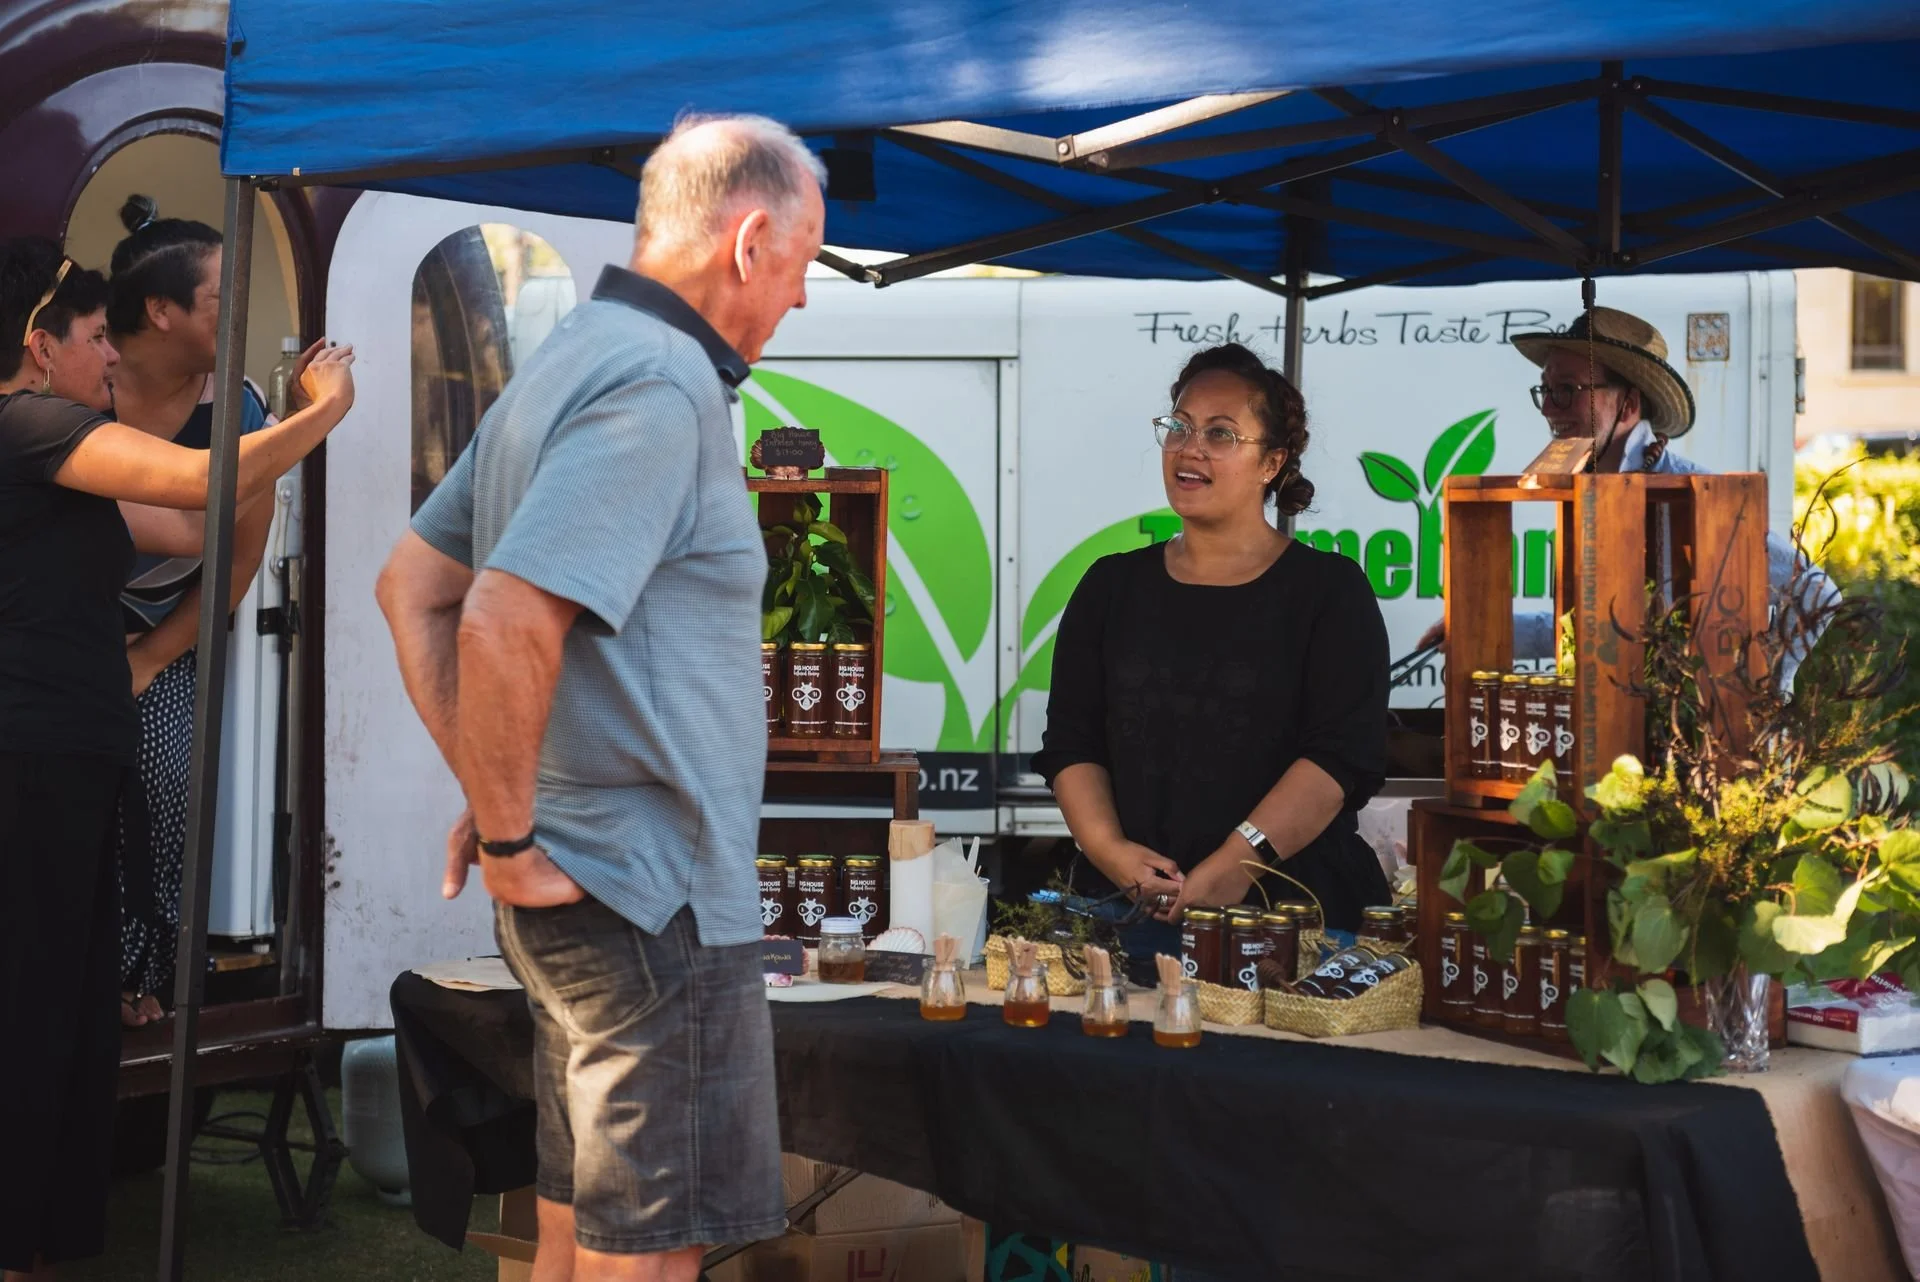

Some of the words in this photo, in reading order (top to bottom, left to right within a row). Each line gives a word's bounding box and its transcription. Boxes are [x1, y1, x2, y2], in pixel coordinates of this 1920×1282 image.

[1134, 312, 1253, 345] Fresh
[1376, 311, 1490, 345] Taste
[1583, 545, 1597, 611] ANOTHER
[1583, 615, 1597, 638] GO
